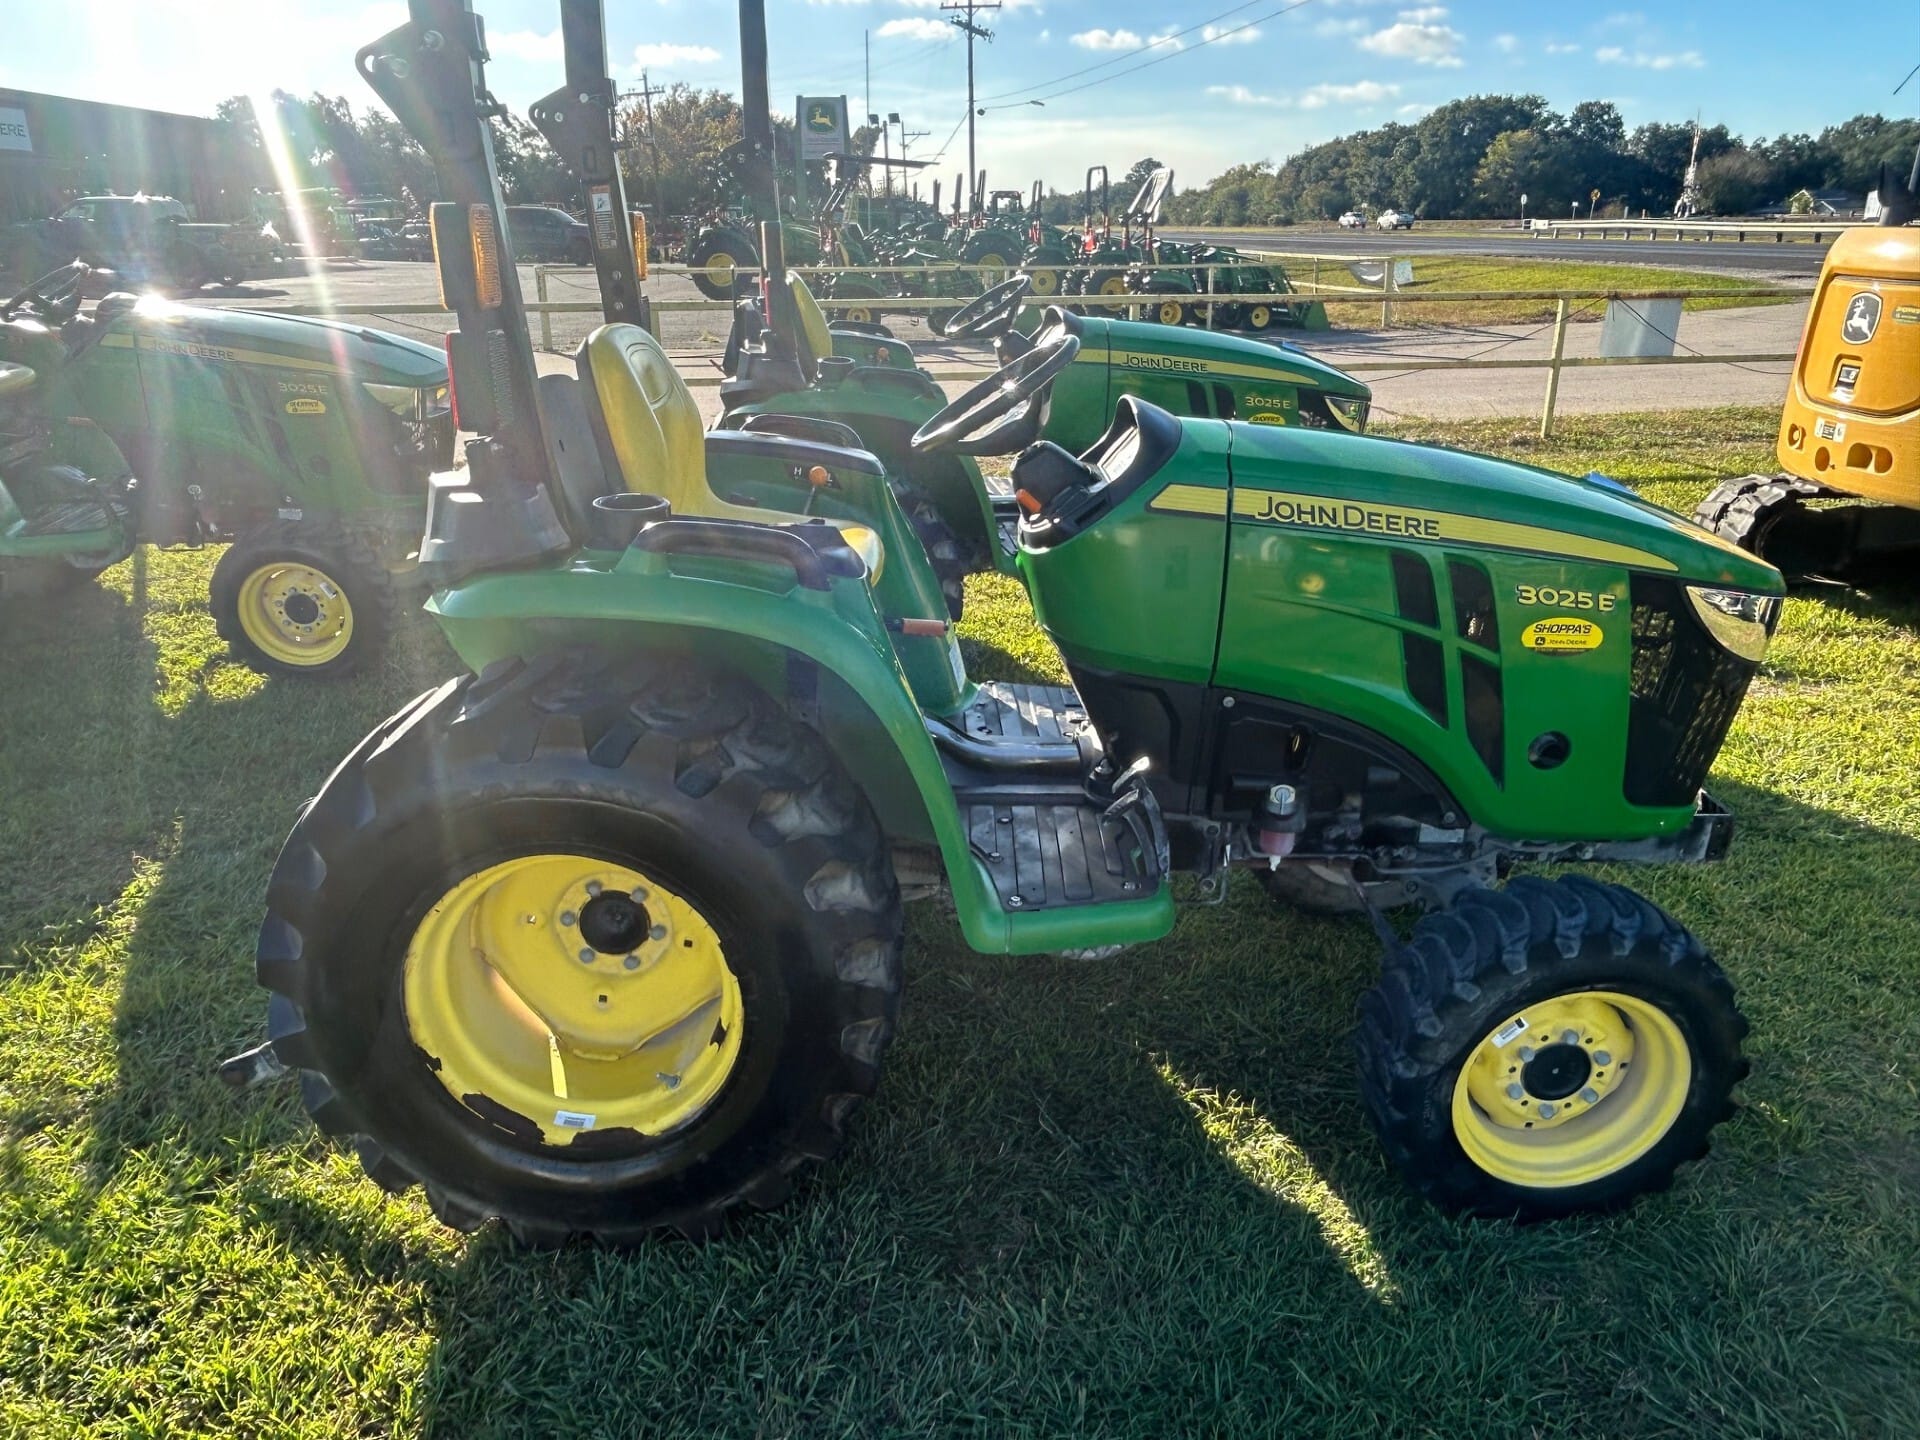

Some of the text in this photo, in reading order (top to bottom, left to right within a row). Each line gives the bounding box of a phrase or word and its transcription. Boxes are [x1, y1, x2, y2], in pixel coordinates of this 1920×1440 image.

[1123, 353, 1209, 372] JOHN DEERE
[1257, 496, 1441, 537] JOHN DEERE
[1533, 623, 1592, 634] SHOPPA'S
